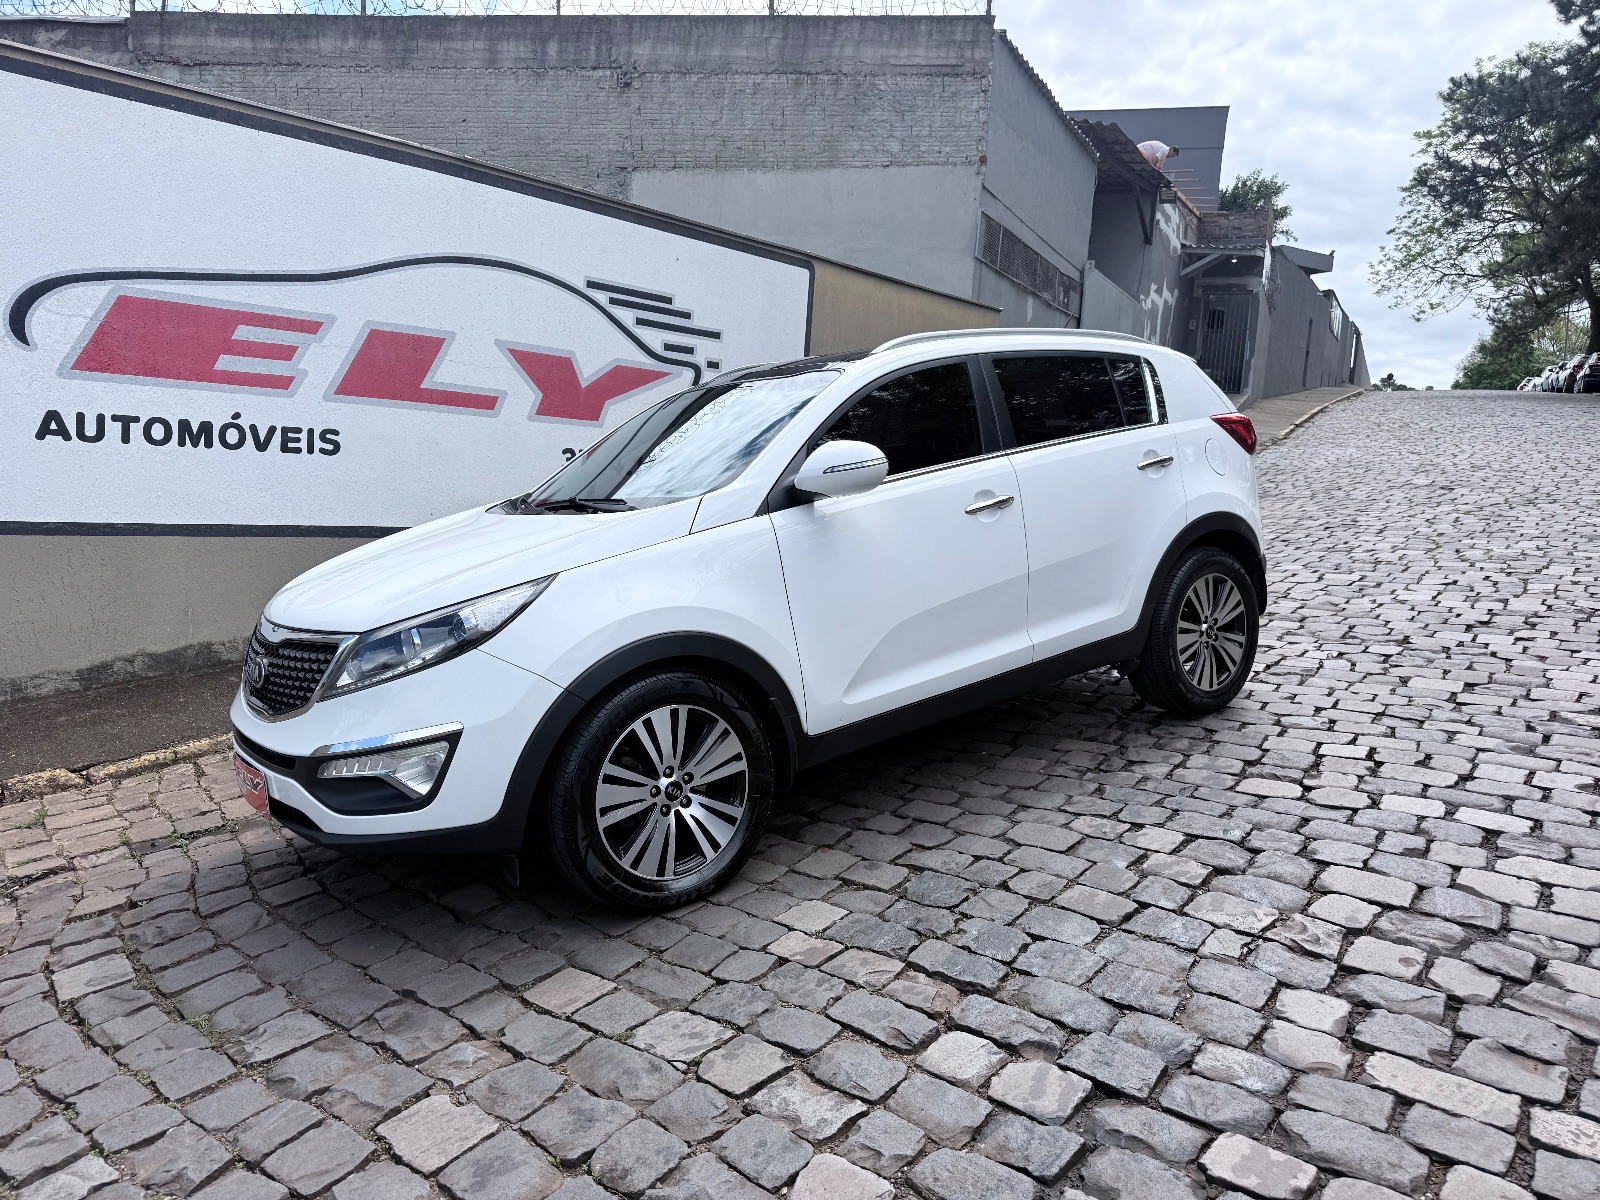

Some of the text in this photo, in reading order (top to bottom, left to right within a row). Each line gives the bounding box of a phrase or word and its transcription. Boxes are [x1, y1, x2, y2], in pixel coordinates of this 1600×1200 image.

[62, 289, 684, 424] ELY
[35, 410, 342, 457] AUTOMÓVEIS
[667, 785, 681, 798] KIA
